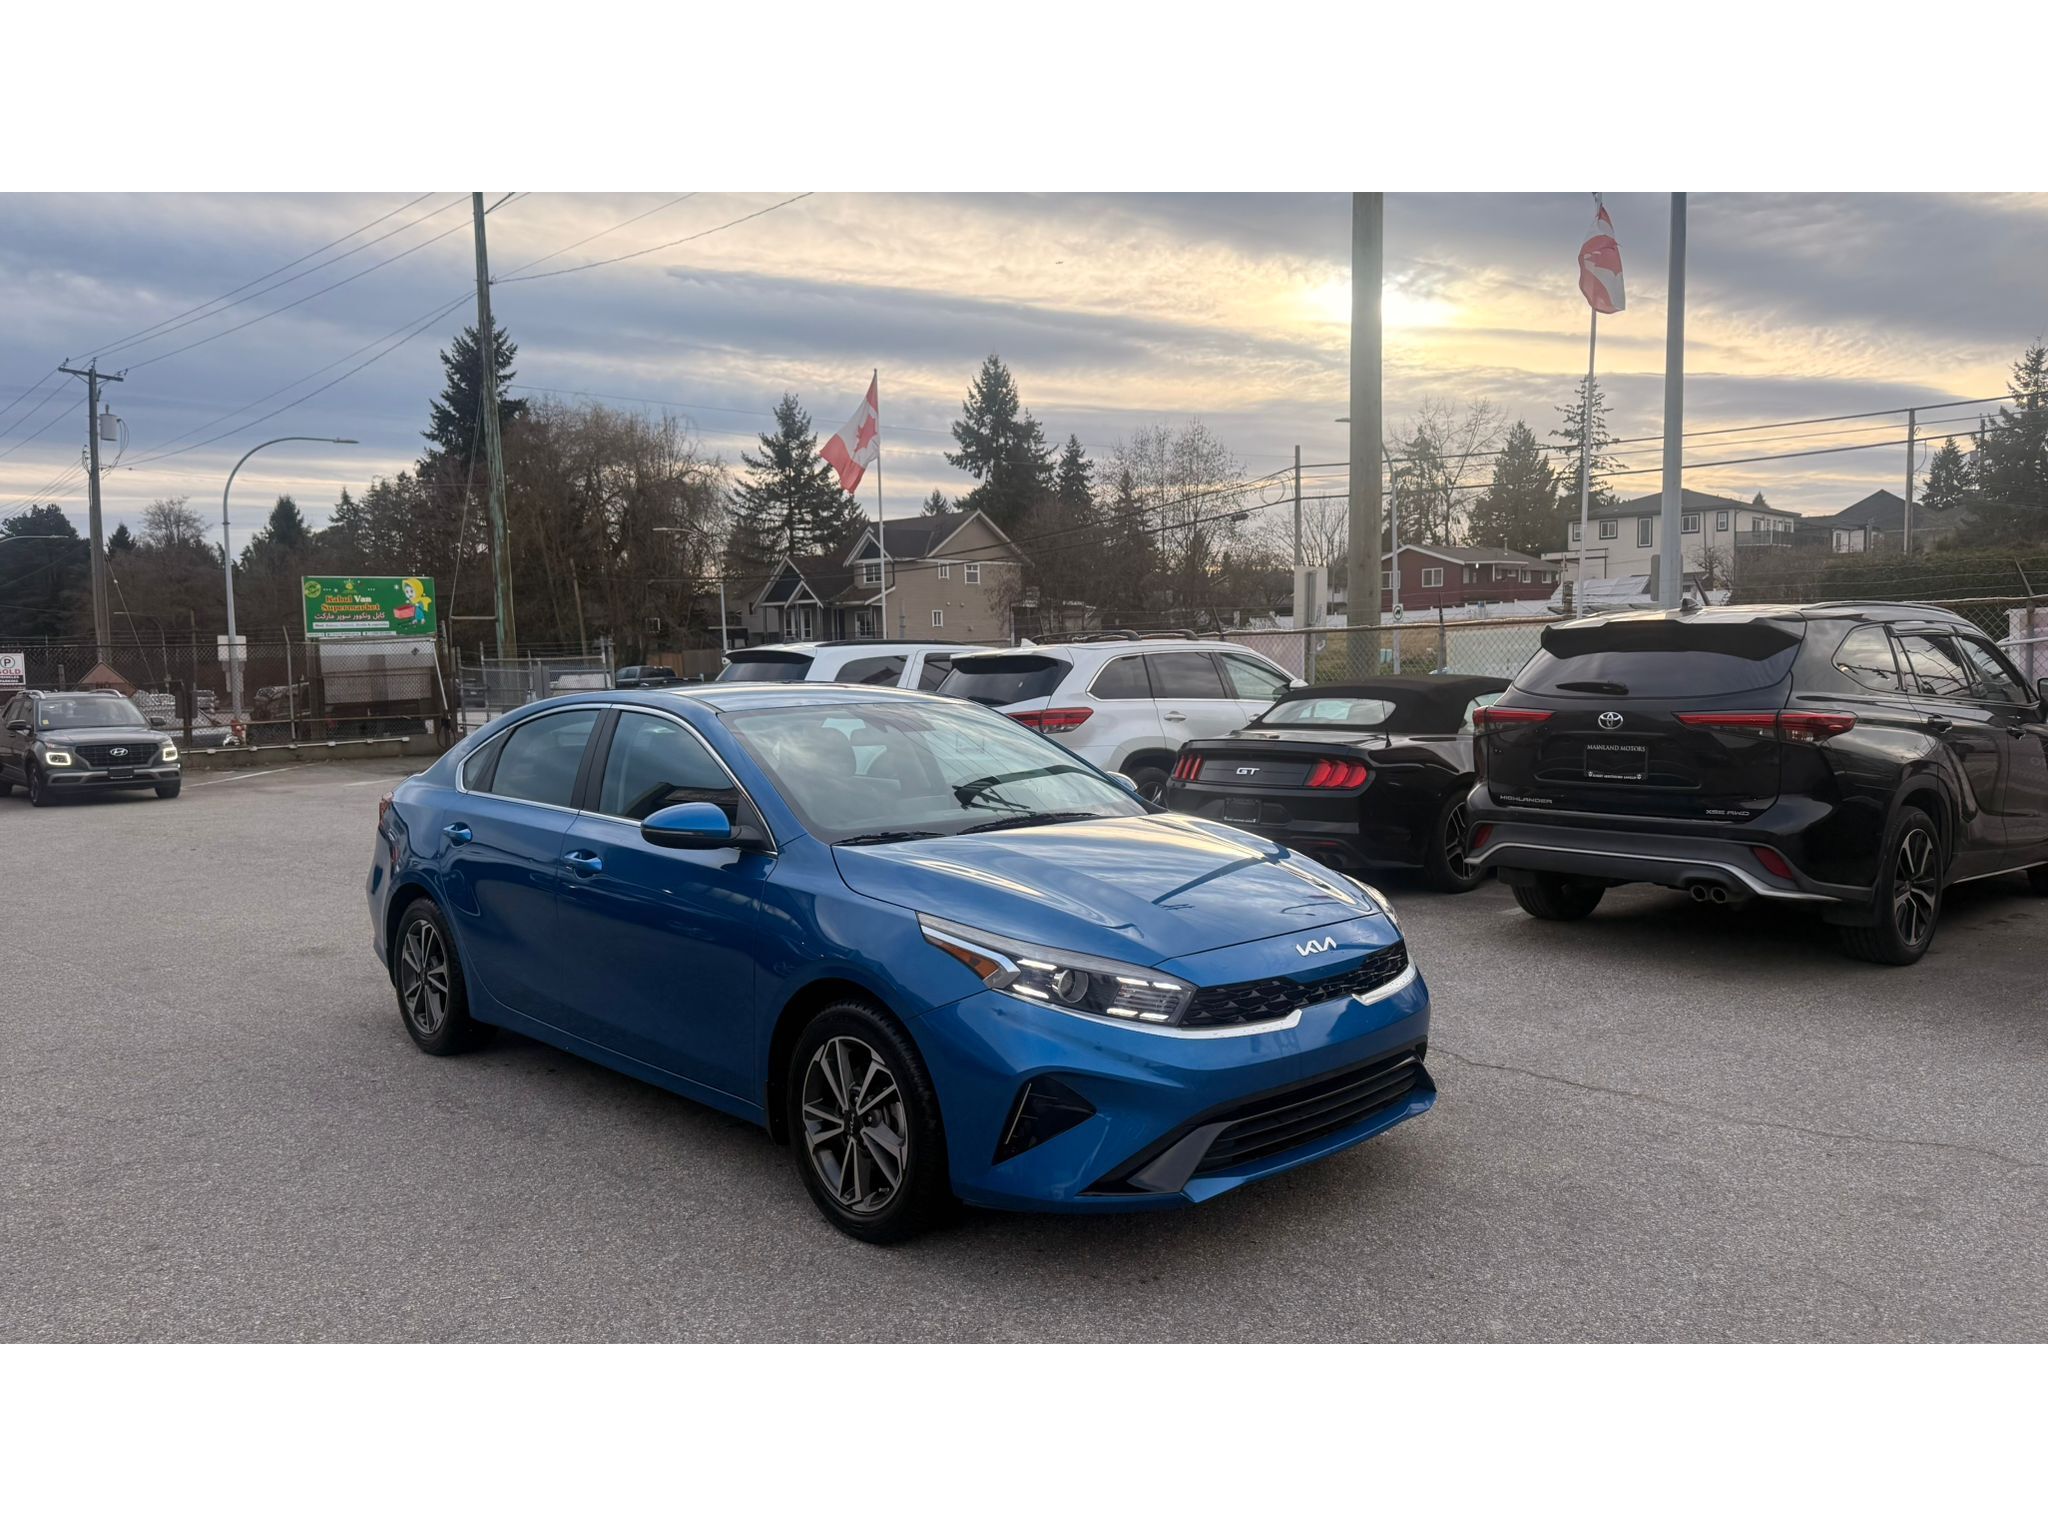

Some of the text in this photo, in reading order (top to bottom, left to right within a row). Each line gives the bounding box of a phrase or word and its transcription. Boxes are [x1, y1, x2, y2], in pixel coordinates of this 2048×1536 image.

[4, 659, 11, 667] P
[1236, 767, 1260, 775] GT
[1500, 795, 1553, 804] HIGHLANDER
[1295, 936, 1337, 957] KIA
